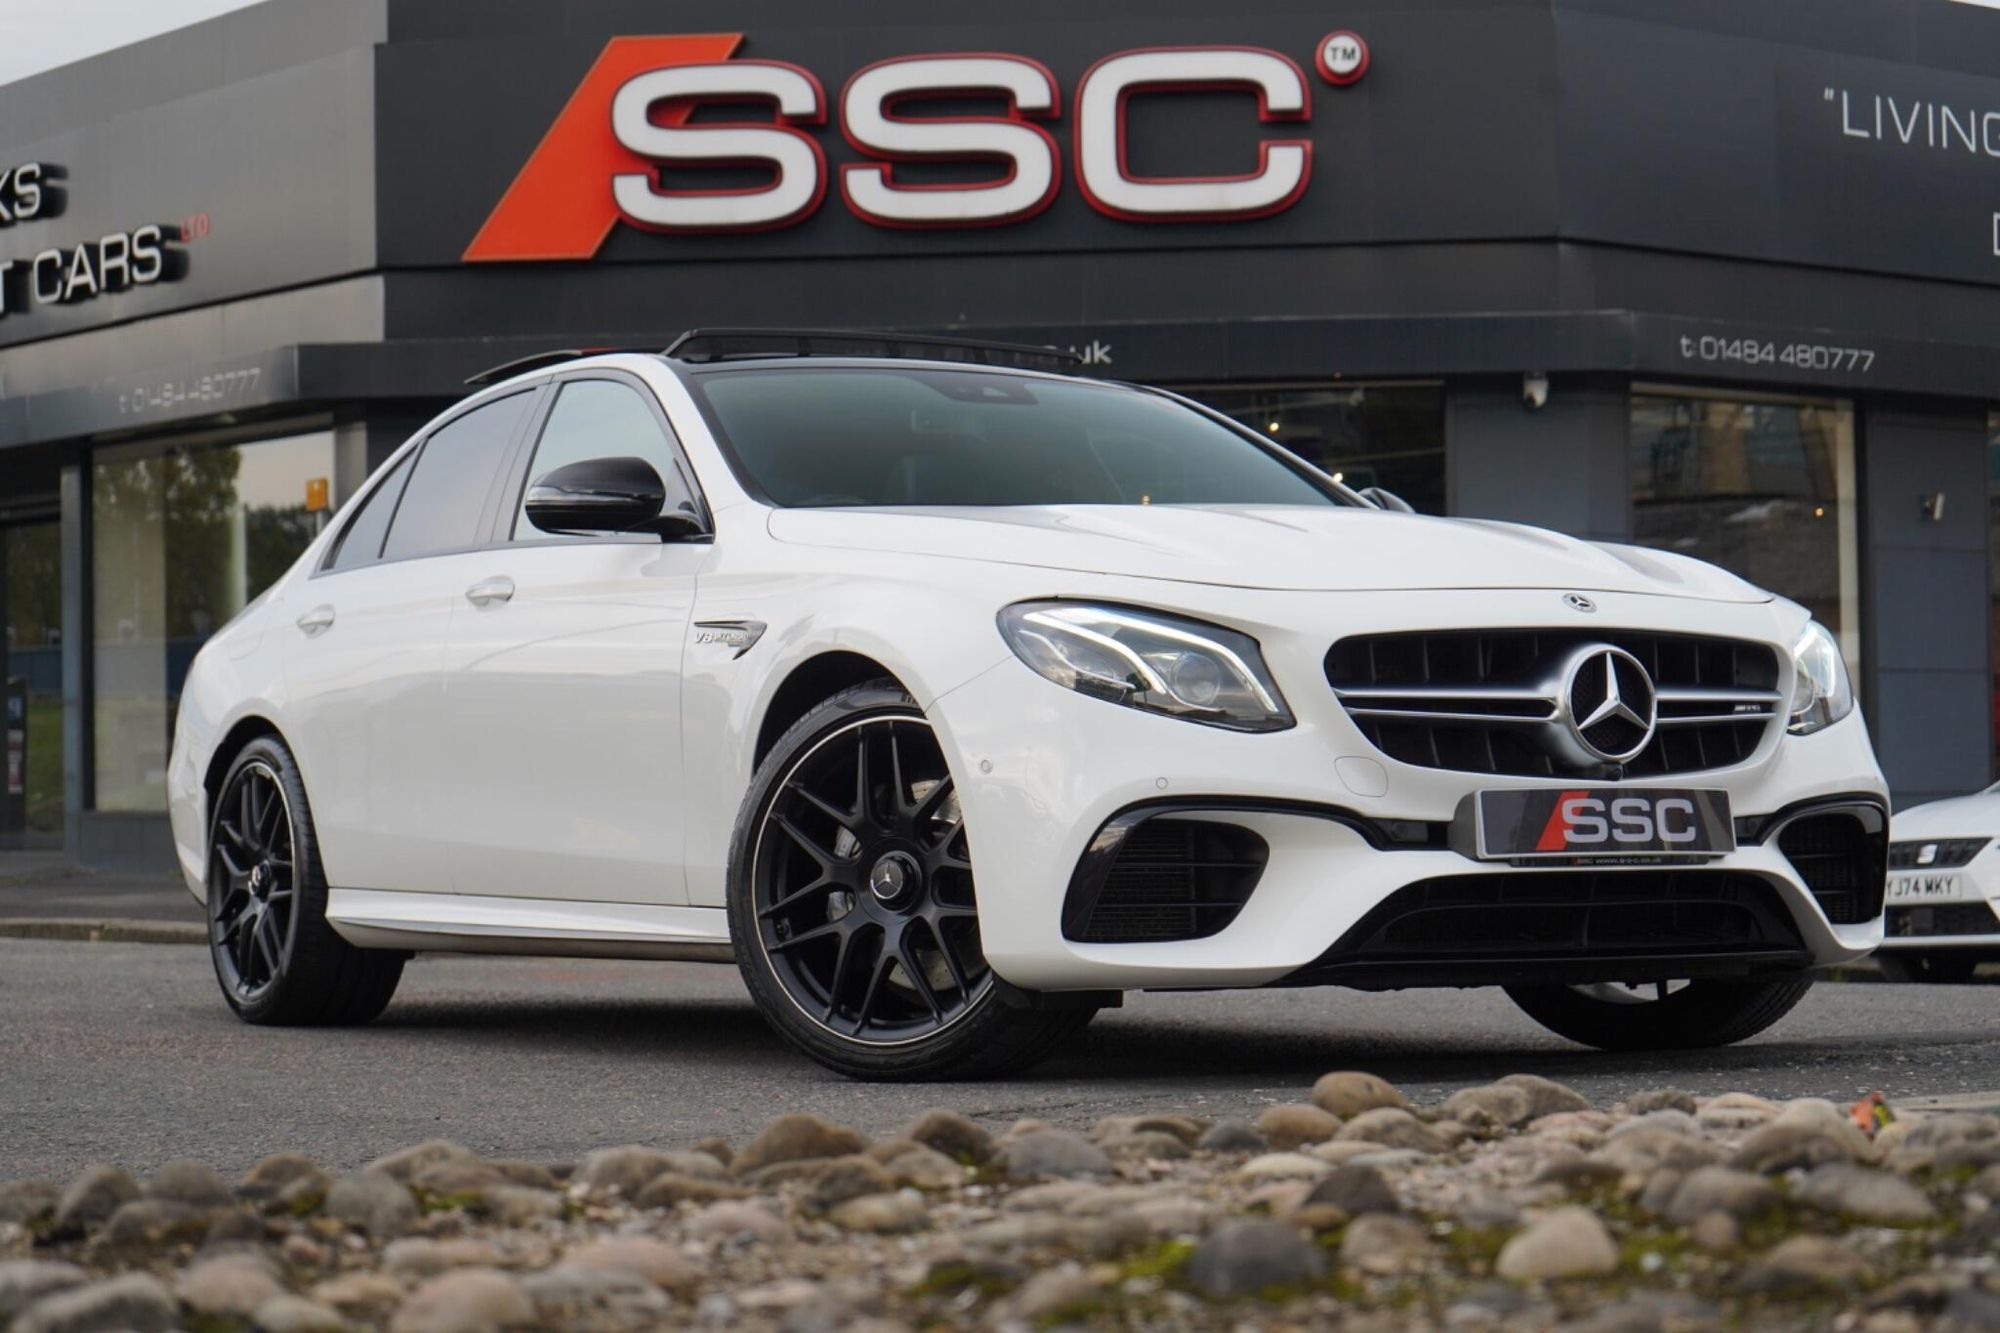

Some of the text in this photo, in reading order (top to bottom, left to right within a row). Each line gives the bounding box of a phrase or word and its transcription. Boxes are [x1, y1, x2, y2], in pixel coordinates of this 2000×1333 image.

[1329, 46, 1356, 61] TM
[611, 48, 1311, 230] SSC
[33, 224, 162, 303] CARS
[1562, 798, 1696, 842] SSC
